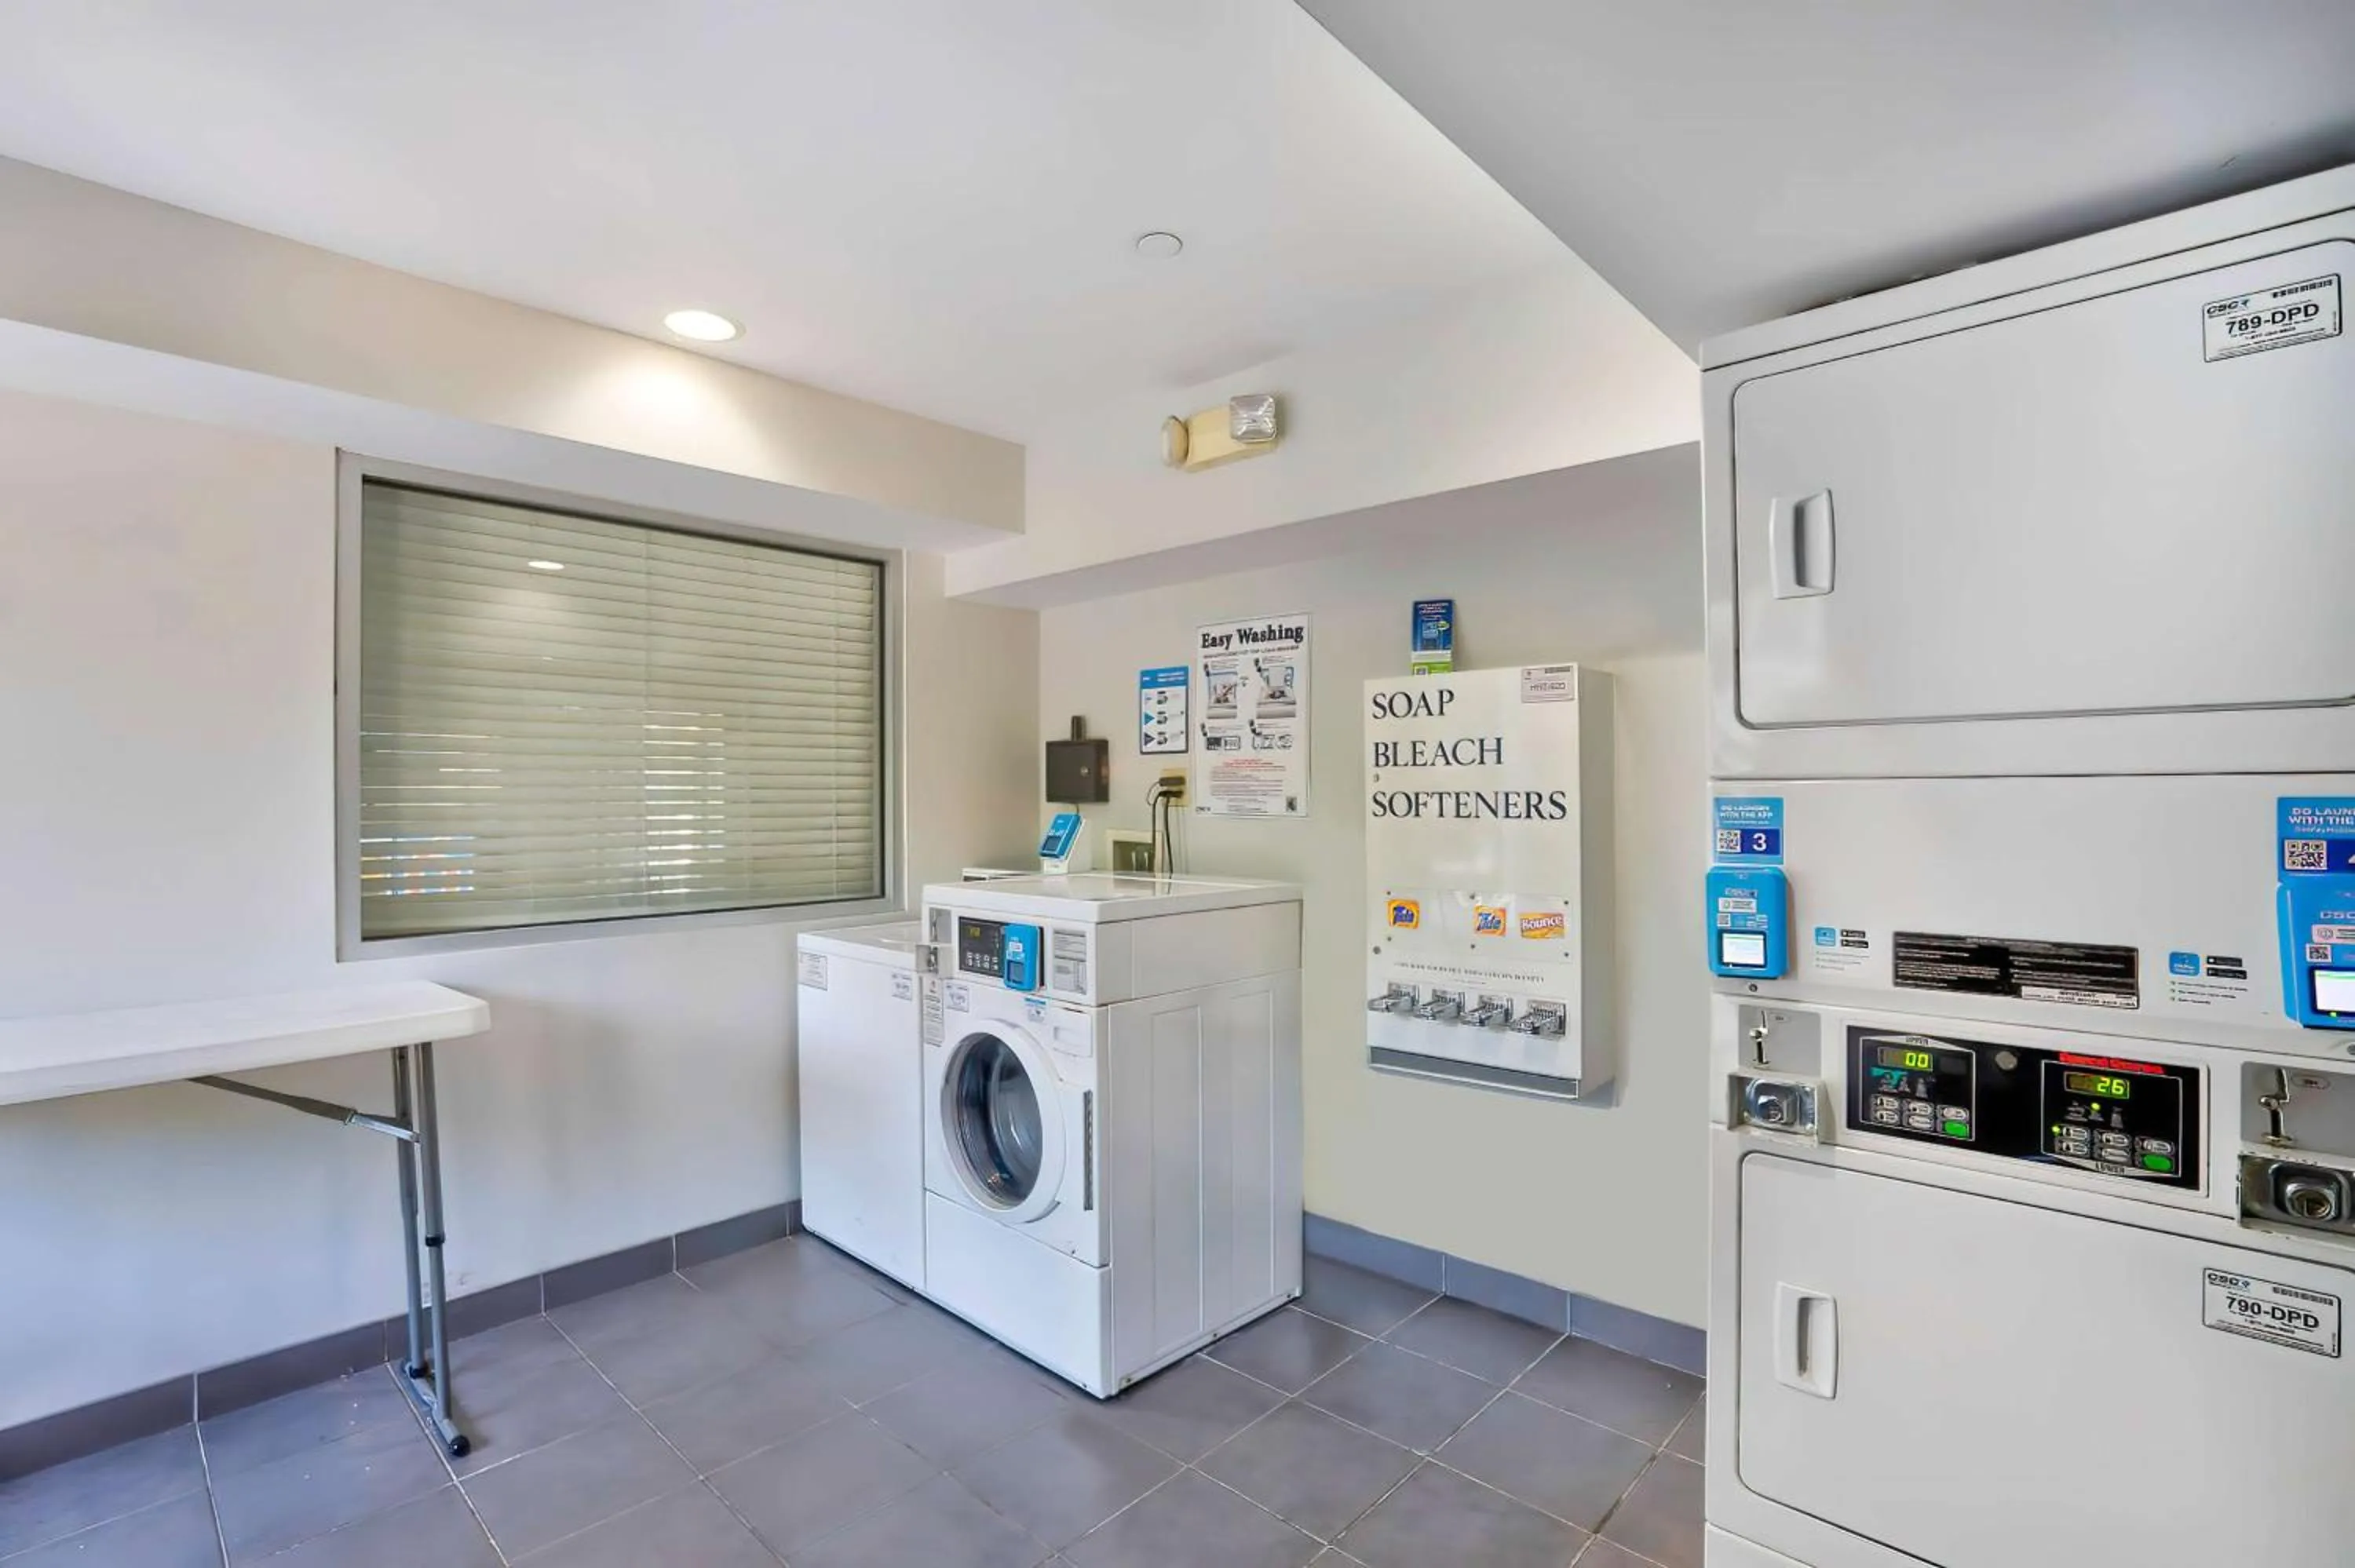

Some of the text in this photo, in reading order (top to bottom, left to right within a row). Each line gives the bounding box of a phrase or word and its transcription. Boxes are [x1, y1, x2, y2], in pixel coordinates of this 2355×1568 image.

[2225, 304, 2320, 334] 789-DPD
[1201, 624, 1304, 650] Easy Washing
[1372, 689, 1455, 720] SOAP
[1373, 737, 1503, 768] BLEACH
[1372, 790, 1567, 820] SOFTENERS
[2288, 816, 2354, 825] WITH THE
[1753, 833, 1767, 851] 3
[1521, 916, 1562, 931] Bounce
[1906, 1052, 1929, 1068] 00
[2097, 1078, 2124, 1094] 26
[2225, 1296, 2320, 1329] 790-DPD
